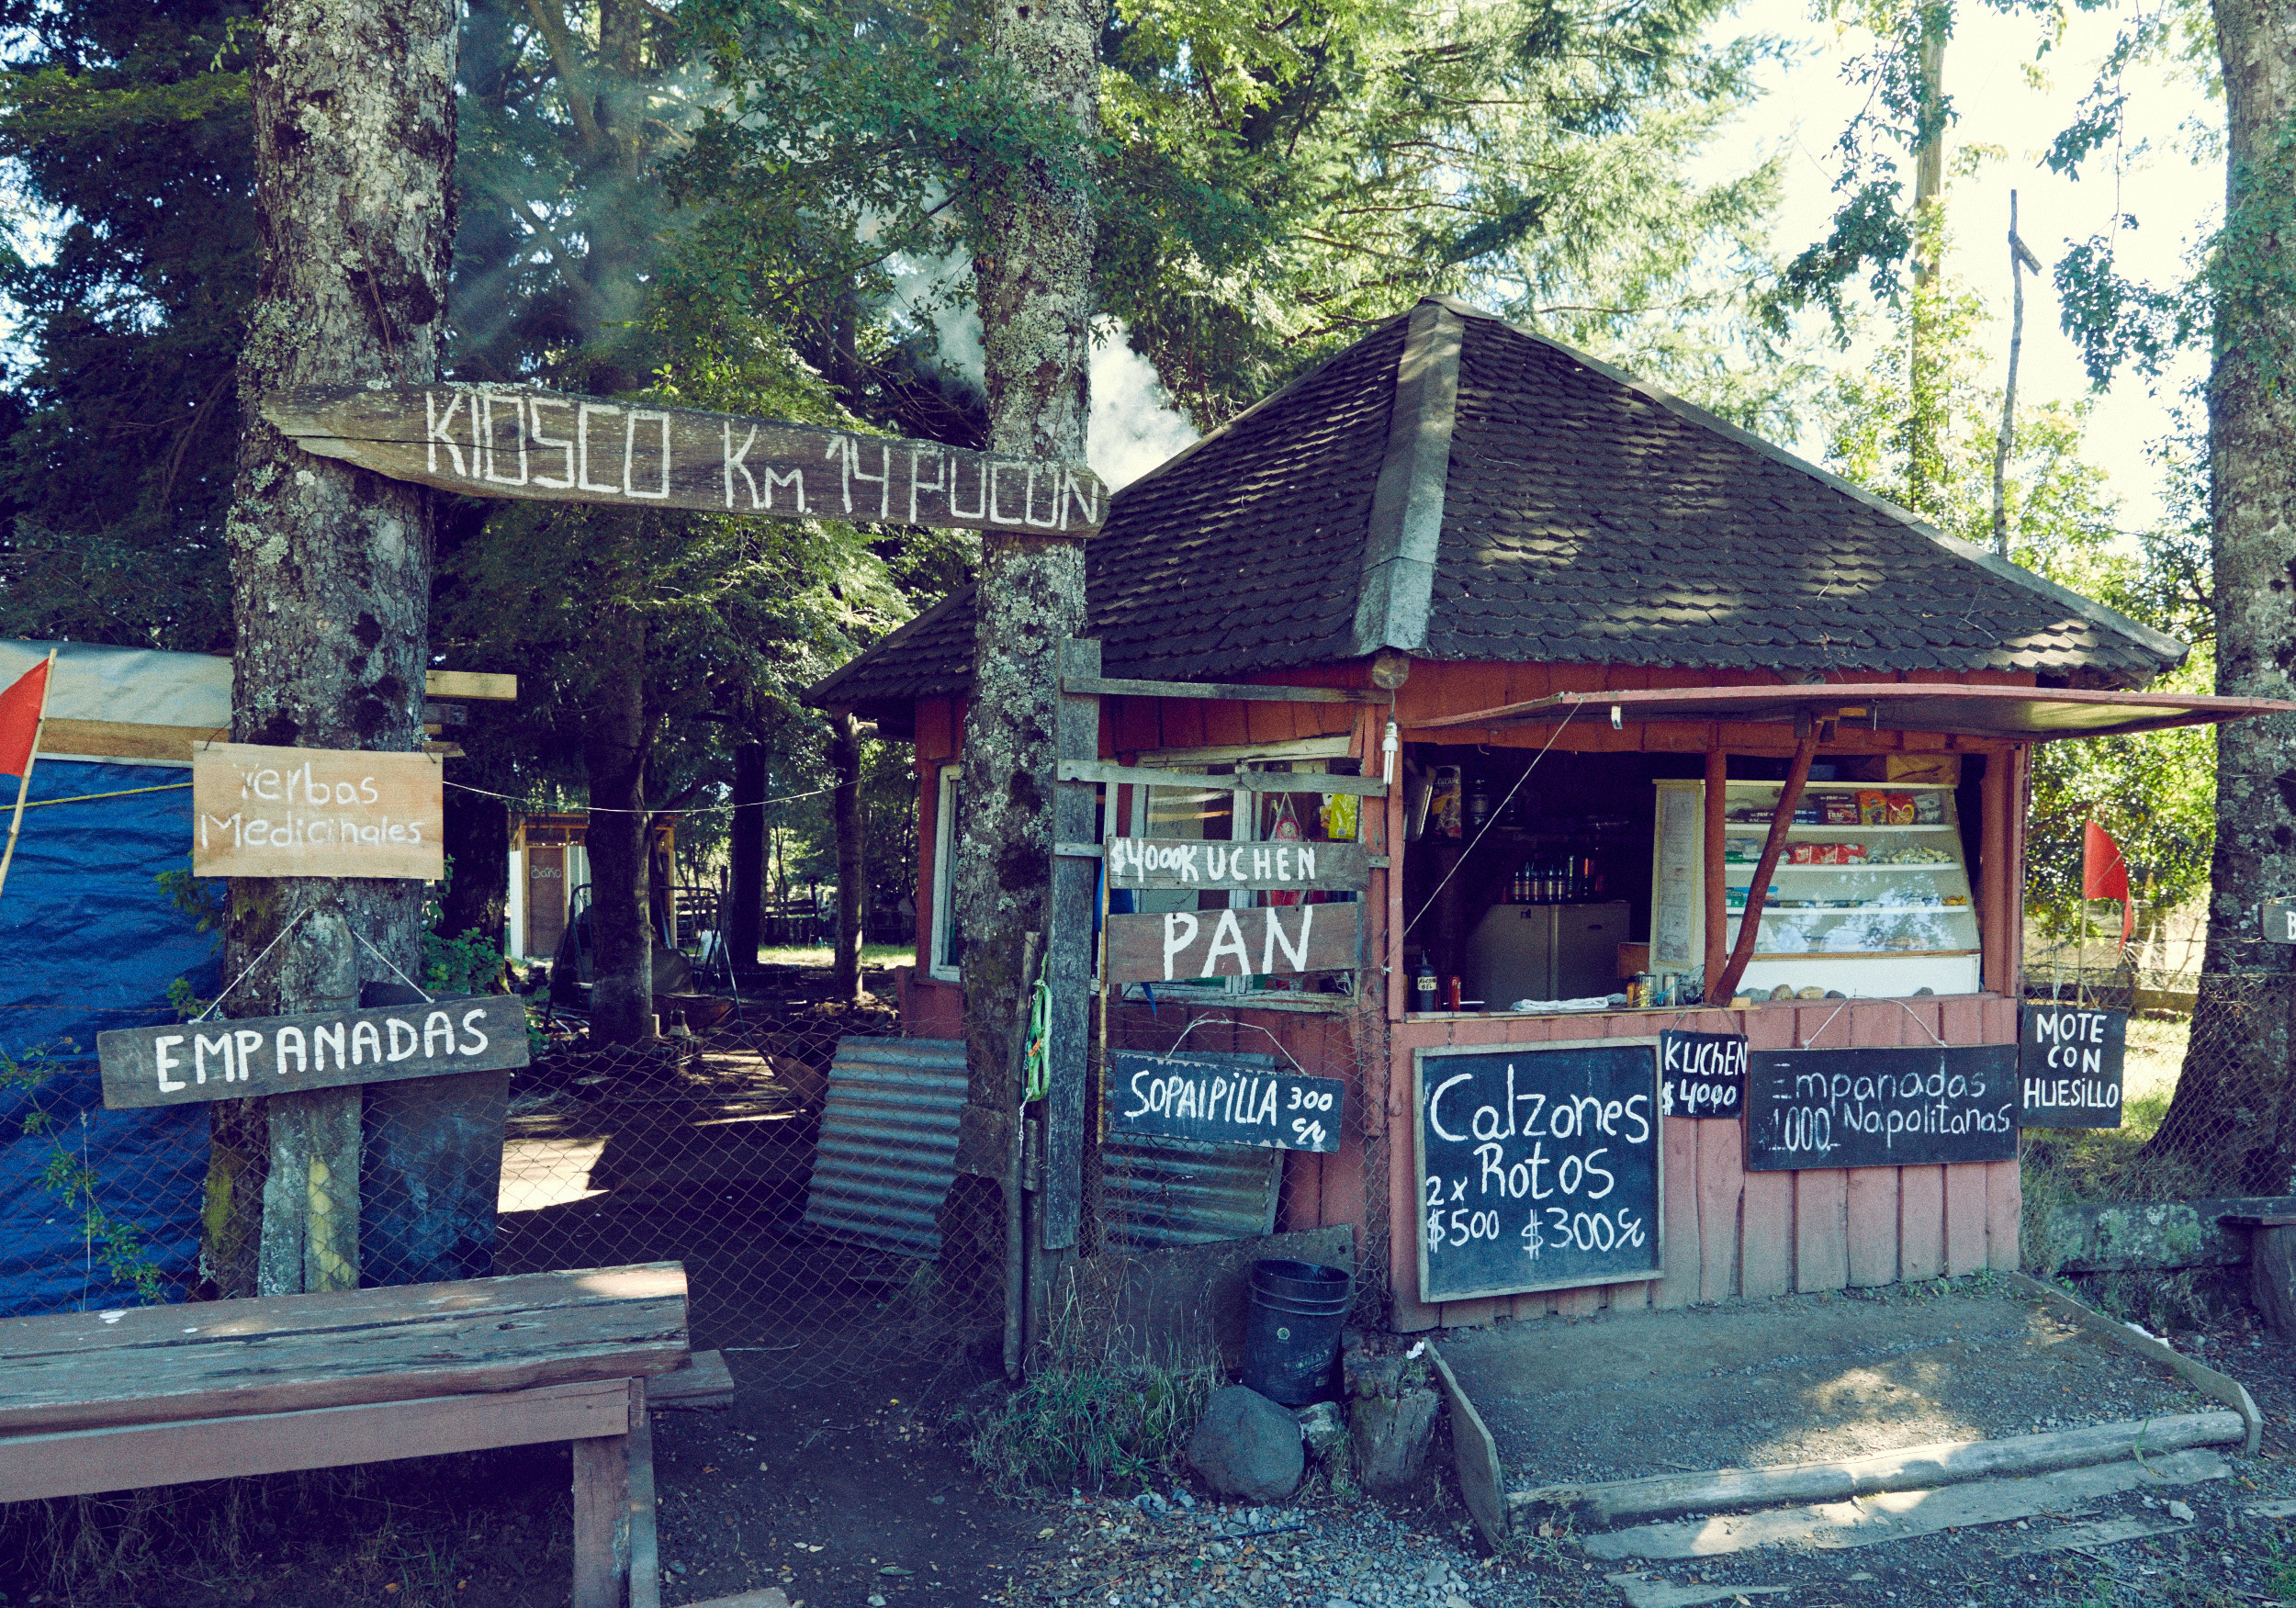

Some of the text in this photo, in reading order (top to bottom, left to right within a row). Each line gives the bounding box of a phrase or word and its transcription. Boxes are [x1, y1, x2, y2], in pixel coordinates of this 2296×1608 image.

[426, 391, 670, 499] KIOSCO
[827, 435, 889, 519] 14
[909, 447, 1099, 531] PUCON
[200, 811, 425, 849] Medicinales
[1181, 844, 1316, 883] KUCHEN
[1164, 905, 1313, 981] PAN
[155, 1008, 489, 1093] EMPANADAS
[2037, 1013, 2108, 1045] MOTE
[2047, 1045, 2101, 1074] CON
[1287, 1086, 1333, 1111] 300
[1430, 1063, 1649, 1143] Calzones
[1772, 1056, 1986, 1117] Empanadas
[1843, 1096, 2012, 1149] Napolitanas
[1473, 1141, 1615, 1200] Rotos
[1426, 1209, 1500, 1254] $500
